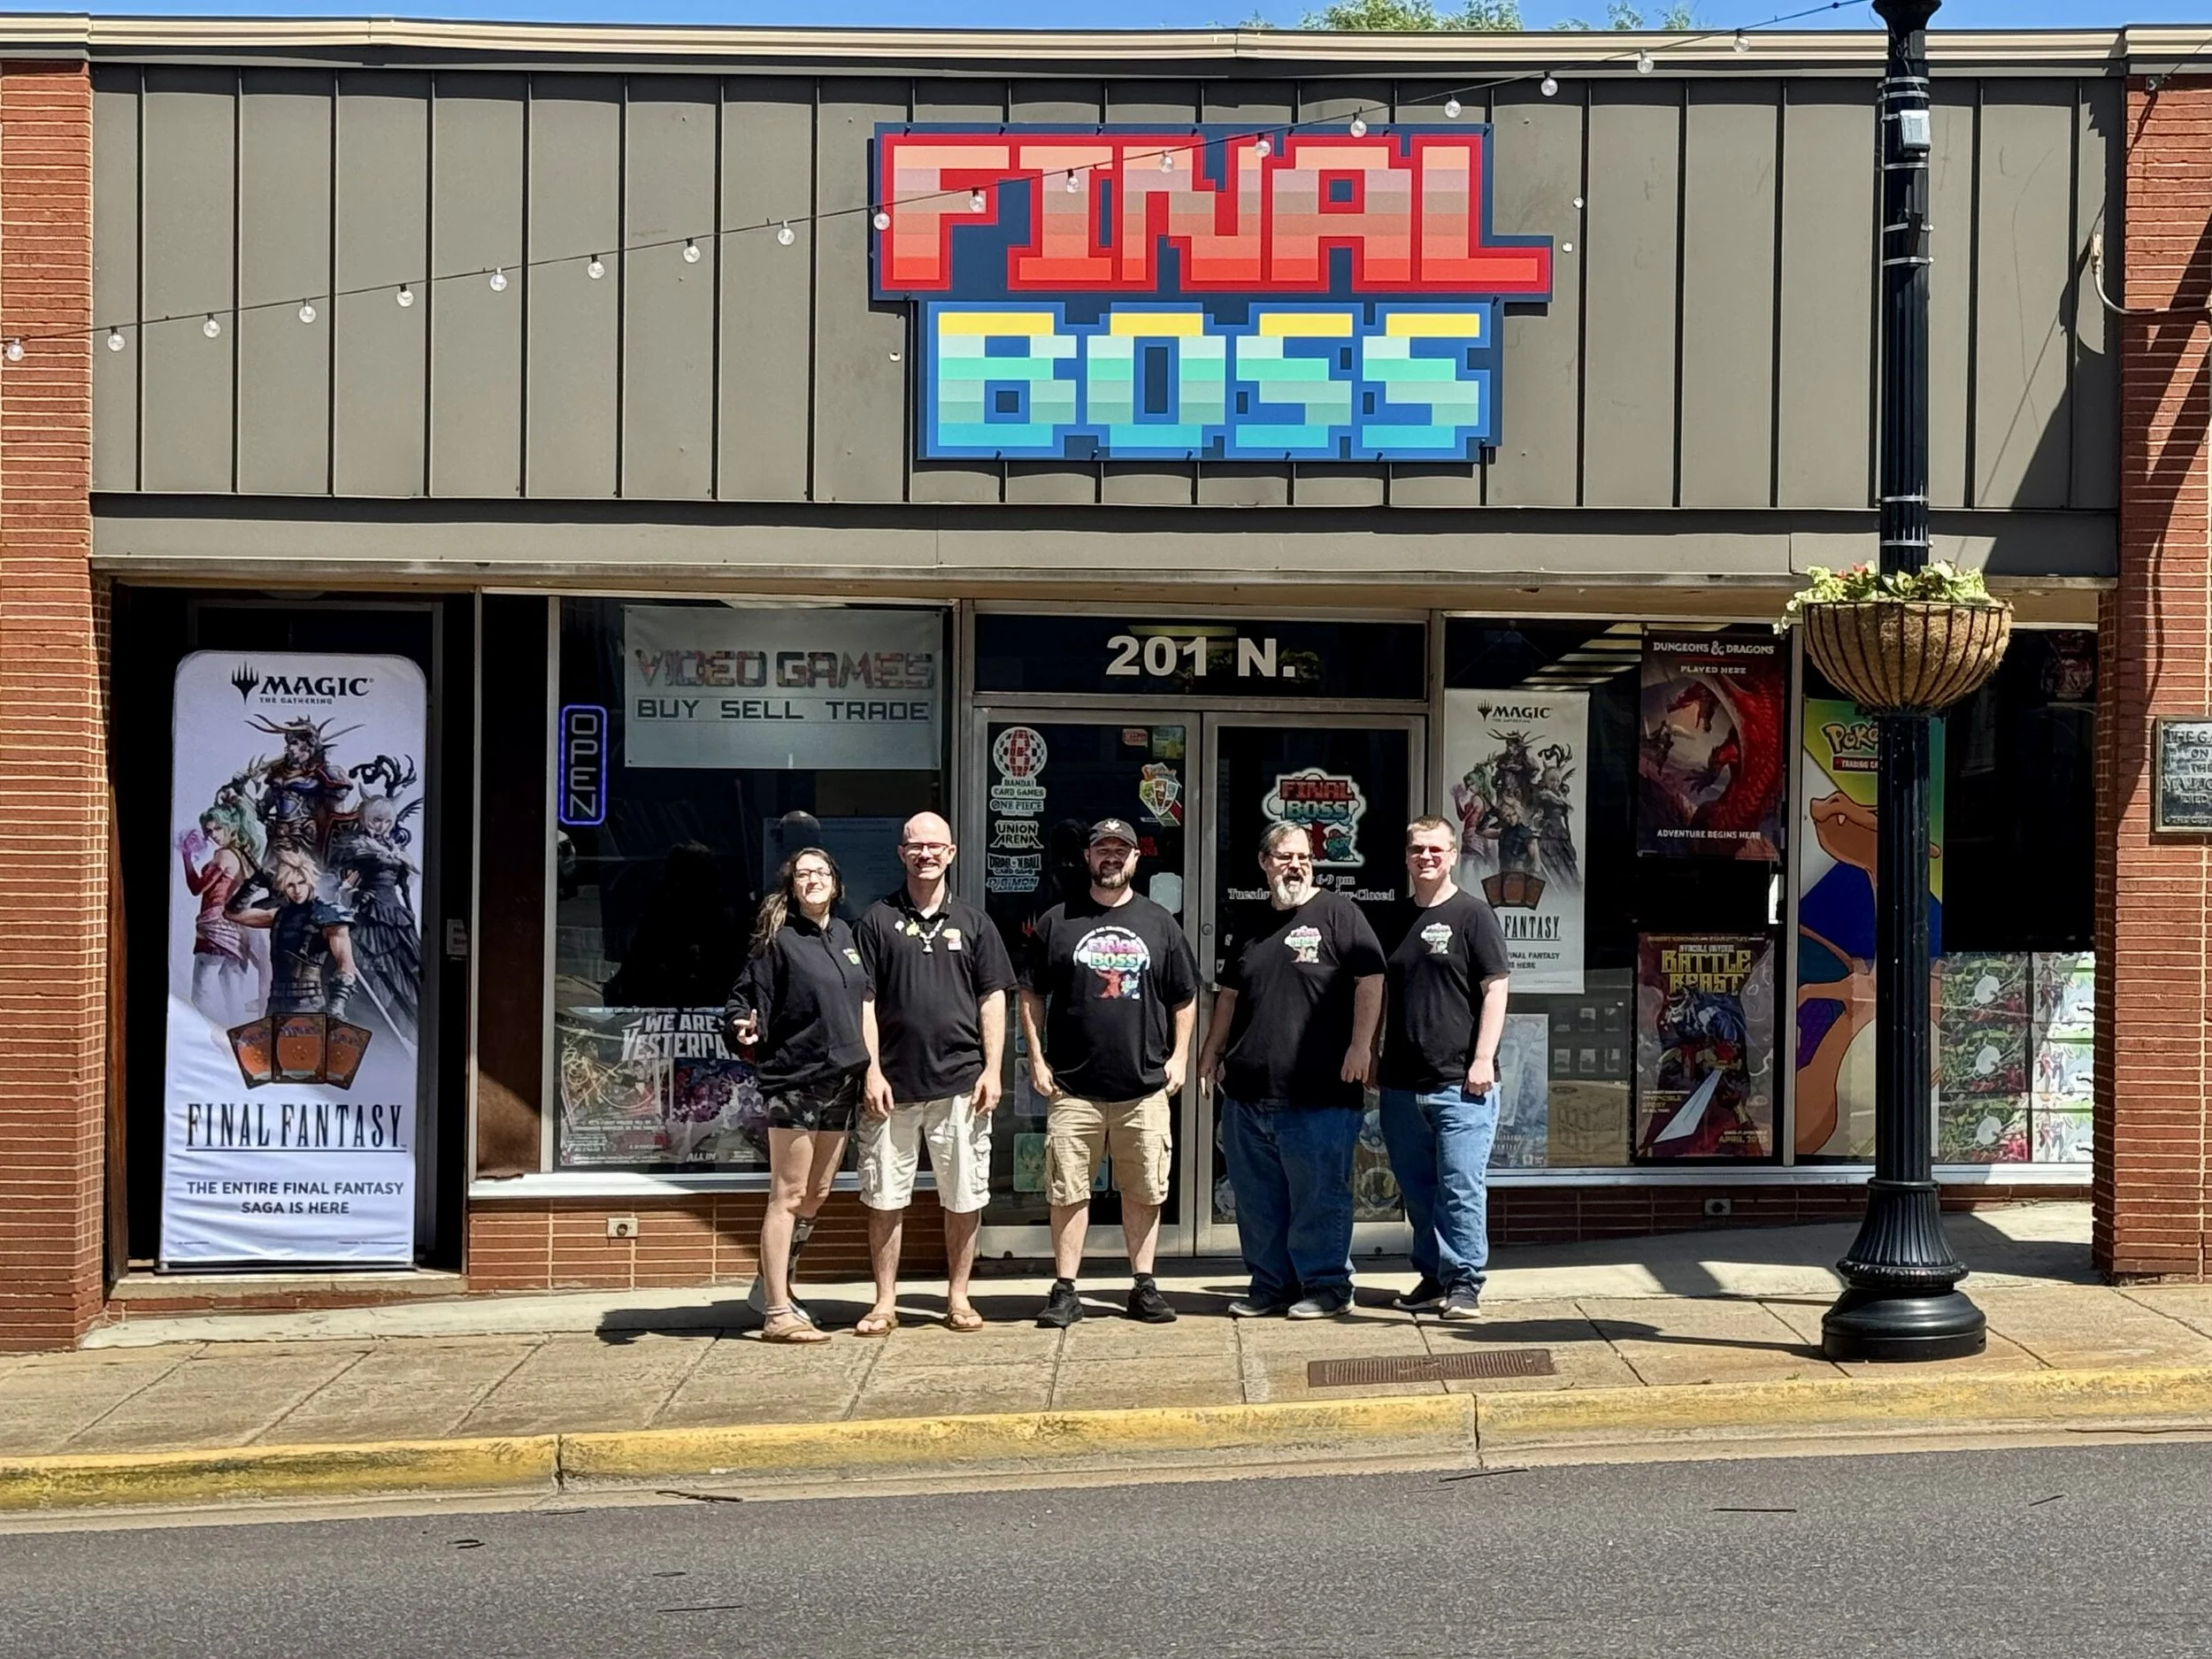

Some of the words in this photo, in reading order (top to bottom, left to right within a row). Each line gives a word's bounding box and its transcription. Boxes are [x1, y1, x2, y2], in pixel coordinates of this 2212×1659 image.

[881, 134, 1550, 292] FINAL
[926, 302, 1491, 458] BOSS
[1106, 634, 1207, 677] 201
[1237, 637, 1296, 678] N.
[1652, 641, 1709, 653] DUNGEONS
[1710, 640, 1724, 656] &
[1725, 644, 1775, 655] DRAGONS
[634, 649, 768, 687] VIDEO
[776, 651, 934, 690] GAMES
[260, 675, 371, 699] MAGIC
[280, 696, 334, 705] GATHERING
[636, 699, 701, 719] BUY
[720, 700, 804, 720] SELL
[825, 701, 930, 721] TRADE
[1492, 705, 1551, 719] MAGIC
[569, 713, 598, 818] OPEN
[994, 787, 1015, 796] CARD
[1017, 788, 1044, 797] GAMES
[1280, 780, 1355, 800] FINAL
[991, 800, 1015, 810] ONE
[1286, 800, 1348, 820] BOSS
[997, 823, 1037, 834] UNION
[1656, 828, 1706, 839] ADVENTURE
[1707, 830, 1738, 840] BEGINS
[990, 833, 1042, 848] ARENA
[1335, 875, 1356, 889] pm
[1504, 915, 1560, 939] FANTASY
[1090, 953, 1138, 967] BOSS
[1660, 949, 1753, 973] BATTLE
[1669, 973, 1745, 996] BEAST
[644, 1014, 676, 1033] WE
[621, 1026, 745, 1062] YESTERDA
[186, 1102, 271, 1148] FINAL
[280, 1103, 403, 1148] FANTASY
[187, 1181, 218, 1194] THE
[222, 1182, 280, 1194] ENTIRE
[282, 1182, 330, 1195] FINAL
[334, 1182, 404, 1195] FANTASY
[241, 1202, 286, 1215] SAGA
[289, 1202, 304, 1215] IS
[308, 1202, 350, 1215] HERE
